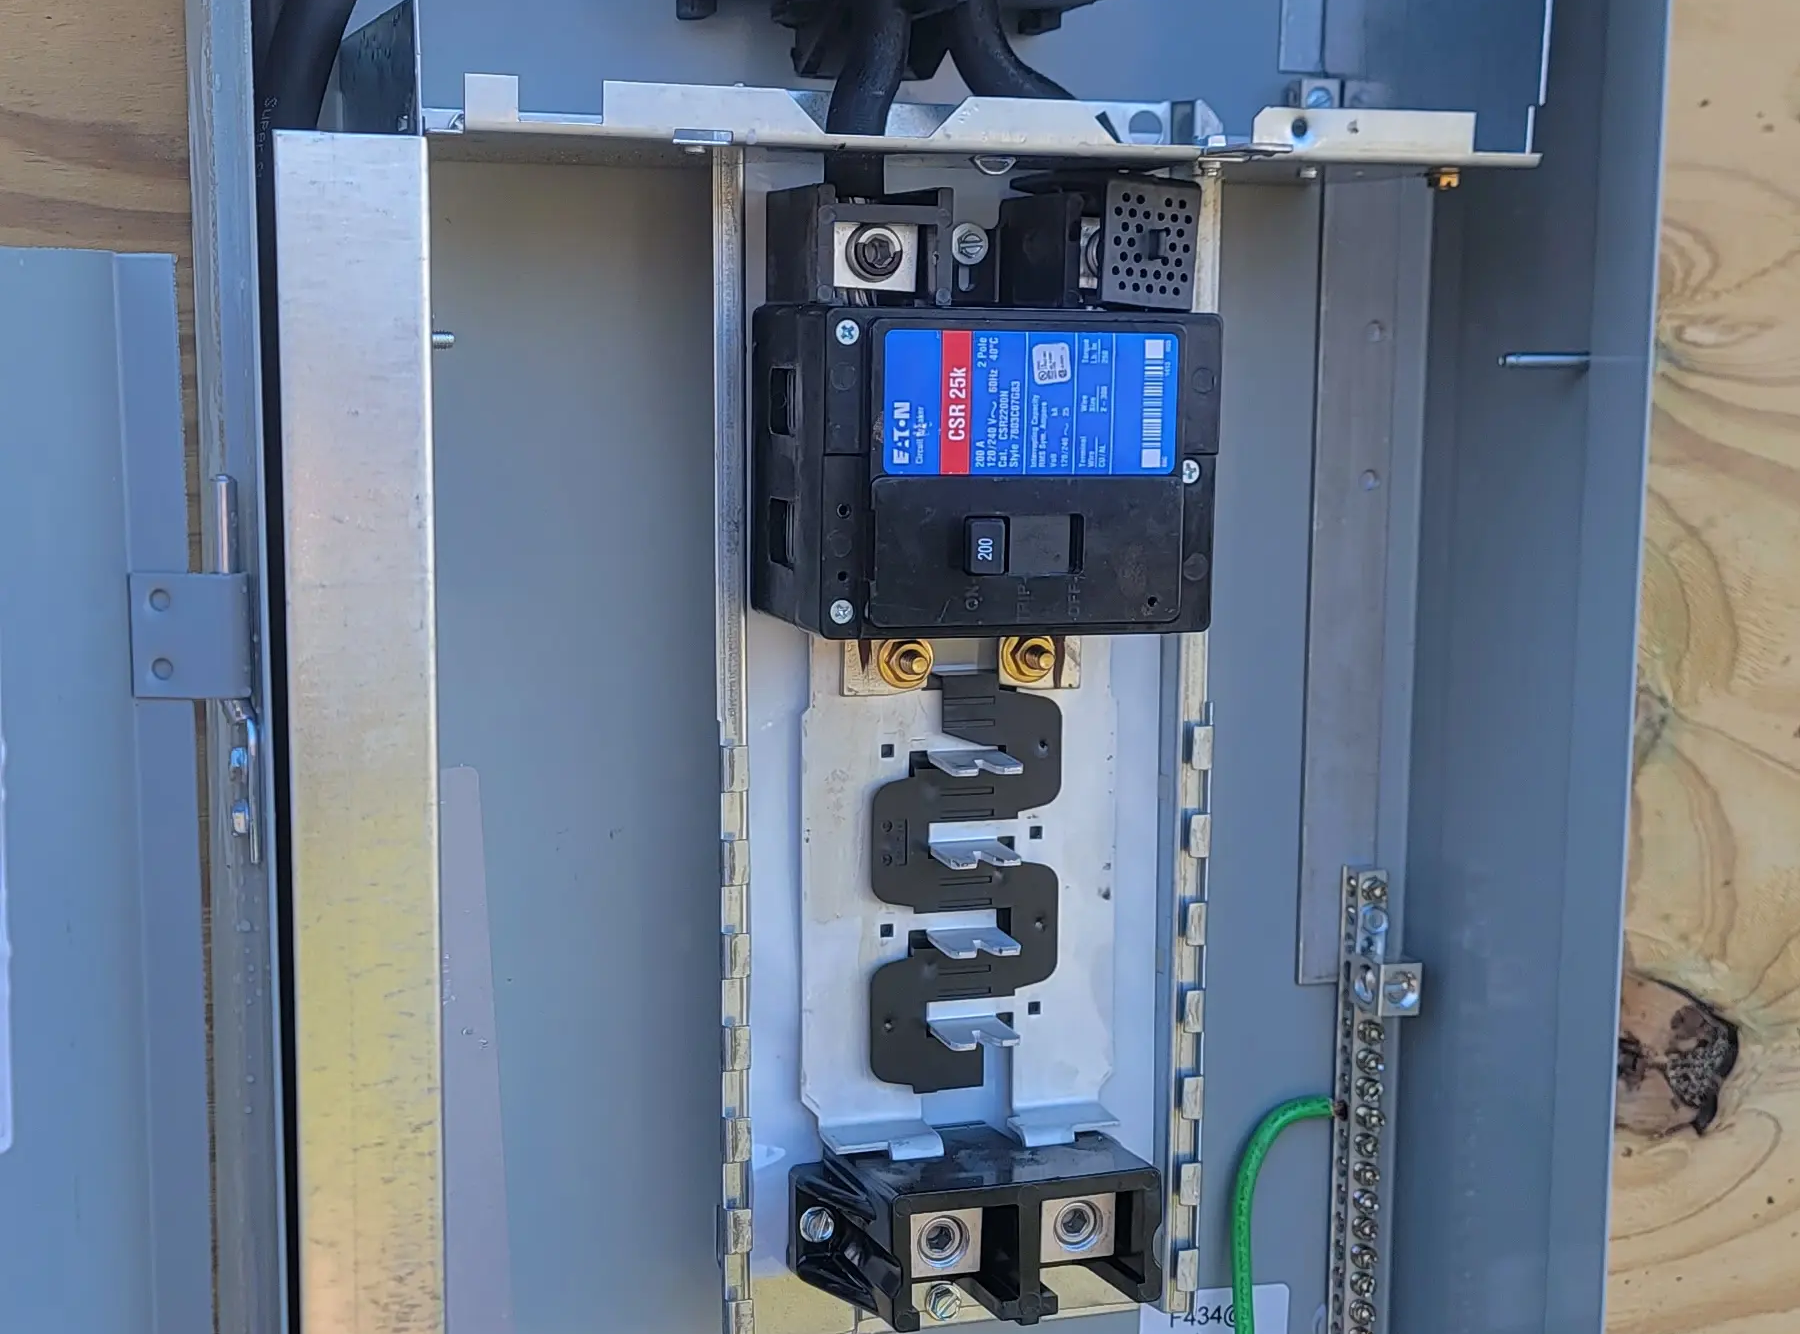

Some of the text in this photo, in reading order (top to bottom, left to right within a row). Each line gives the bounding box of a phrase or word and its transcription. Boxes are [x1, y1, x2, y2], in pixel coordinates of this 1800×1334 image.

[987, 369, 999, 394] 60Hz
[947, 367, 968, 442] CSR 25k
[974, 337, 988, 468] 200 A 2 Pole
[1030, 394, 1041, 425] Capacity
[1079, 394, 1088, 413] Wire
[892, 401, 911, 465] EATON
[986, 427, 997, 468] 120/240
[914, 438, 925, 465] Circuit
[1008, 444, 1020, 468] Style
[1060, 437, 1069, 468] 120/240
[1078, 435, 1088, 468] Terminal
[977, 537, 994, 562] 200
